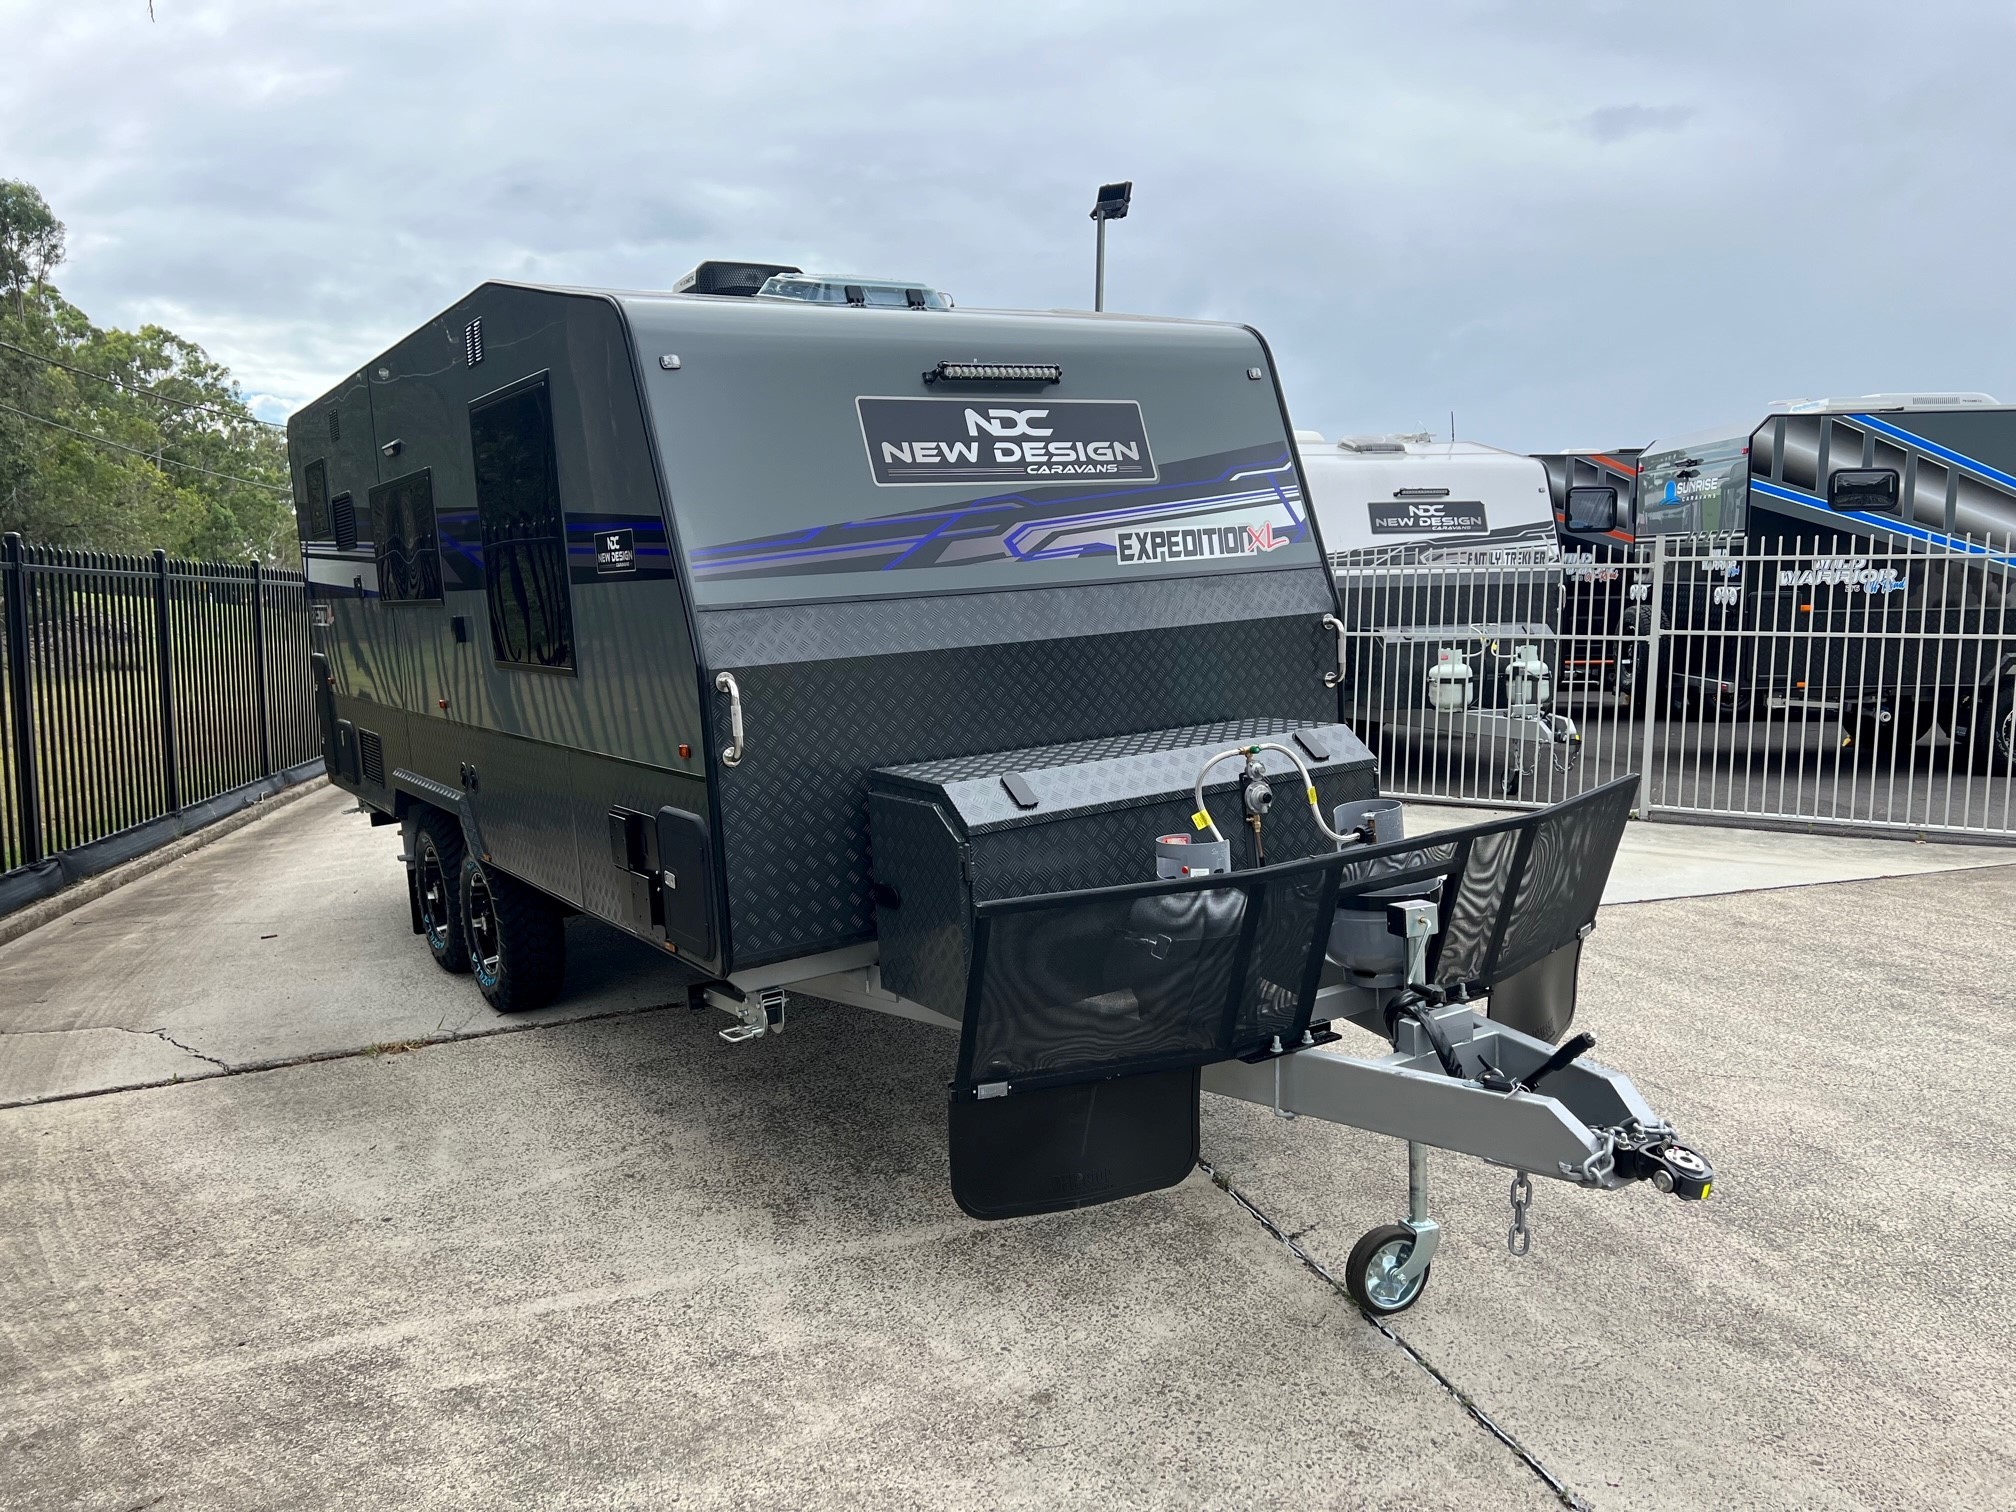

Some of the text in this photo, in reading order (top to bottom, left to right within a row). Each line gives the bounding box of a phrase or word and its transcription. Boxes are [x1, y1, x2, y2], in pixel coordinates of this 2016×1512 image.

[964, 407, 1054, 437] NDC
[881, 441, 1140, 464] NEW DESIGN
[1026, 464, 1118, 475] CARAVANS
[1677, 477, 1718, 494] SUNRISE
[1409, 504, 1446, 517] NDC
[1375, 516, 1482, 528] NEW DESIGN
[606, 535, 620, 551] NDC
[597, 550, 633, 563] NEW DESIGN
[1779, 569, 1898, 586] WARRIOR
